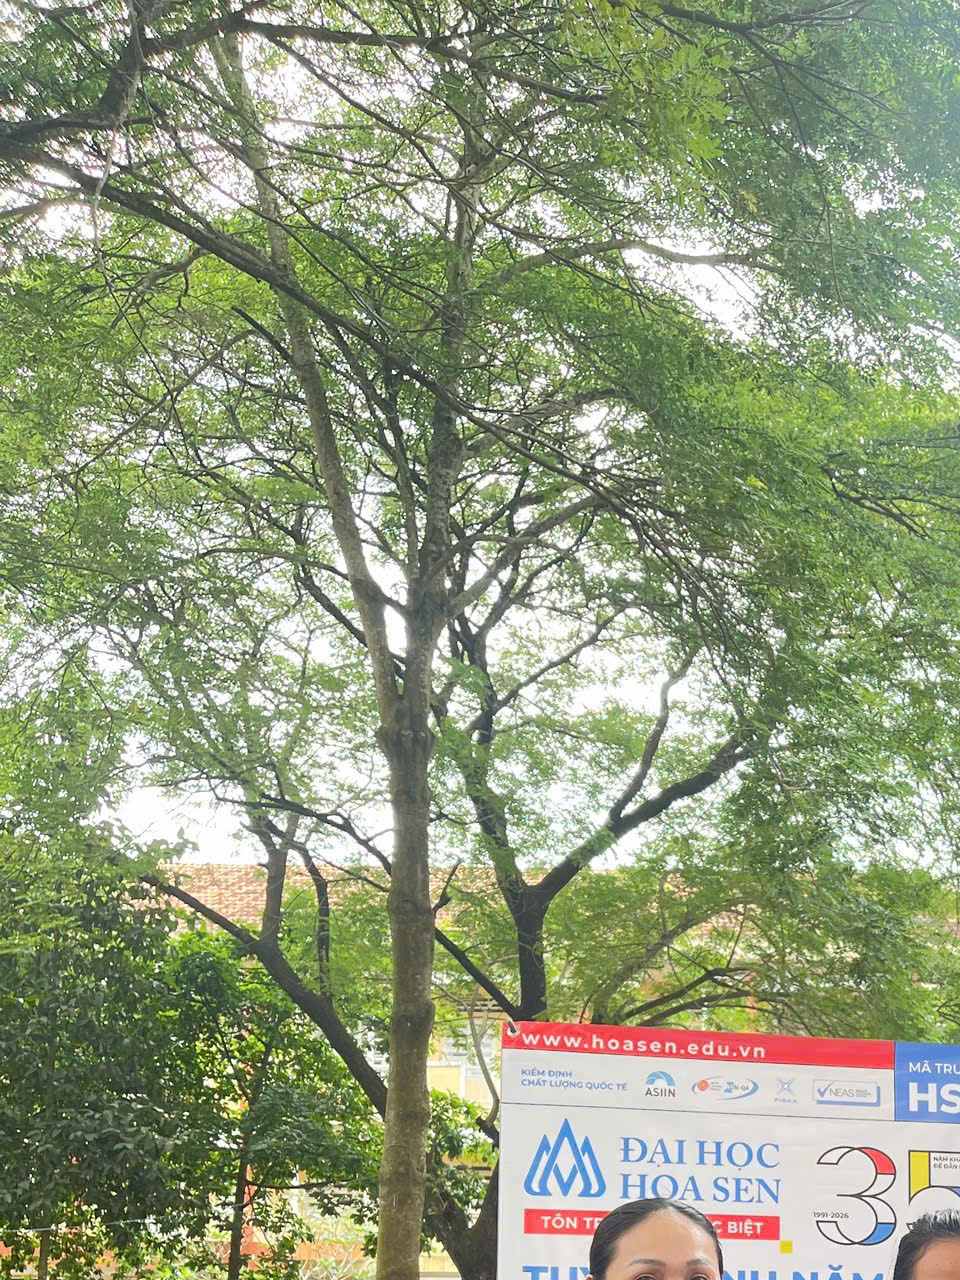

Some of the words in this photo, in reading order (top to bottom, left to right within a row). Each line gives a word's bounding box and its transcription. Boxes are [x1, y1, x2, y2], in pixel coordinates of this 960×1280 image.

[522, 1033, 766, 1058] www.hoasen.edu.vn
[909, 1060, 931, 1073] MÃ
[547, 1069, 573, 1079] ĐỊNH
[520, 1076, 547, 1088] CHẤT
[549, 1079, 584, 1091] LƯỢNG
[645, 1087, 676, 1098] ASIIN
[830, 1087, 855, 1098] NEAS
[620, 1136, 687, 1168] ĐẠI
[696, 1140, 780, 1171] HỌC
[619, 1173, 705, 1201] HOA
[712, 1176, 782, 1204] SEN
[813, 1211, 850, 1219] 1991-2026
[541, 1212, 578, 1230] TÔN
[728, 1220, 764, 1237] BIỆT
